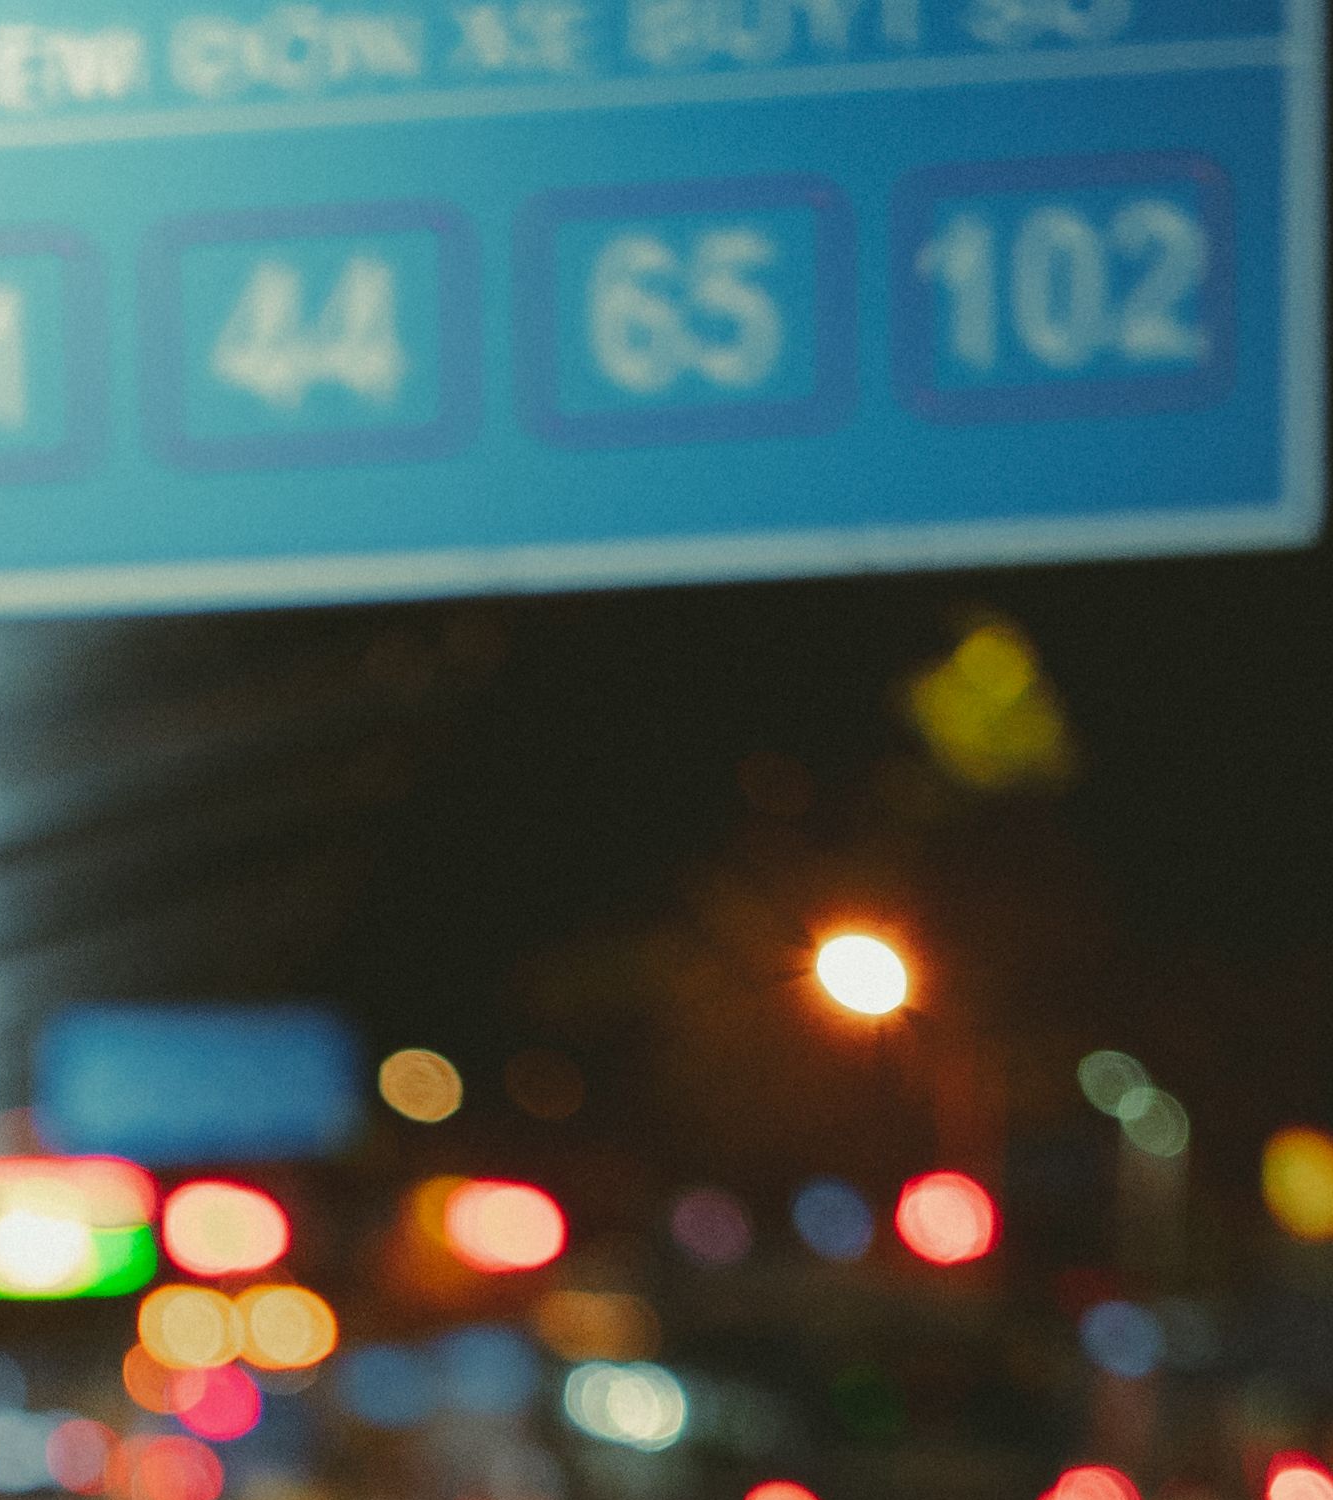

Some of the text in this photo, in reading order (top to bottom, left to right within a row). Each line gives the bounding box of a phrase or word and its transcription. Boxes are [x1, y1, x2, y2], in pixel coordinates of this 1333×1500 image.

[207, 248, 411, 412] 44
[585, 218, 783, 396] 65
[915, 196, 1213, 374] 102
